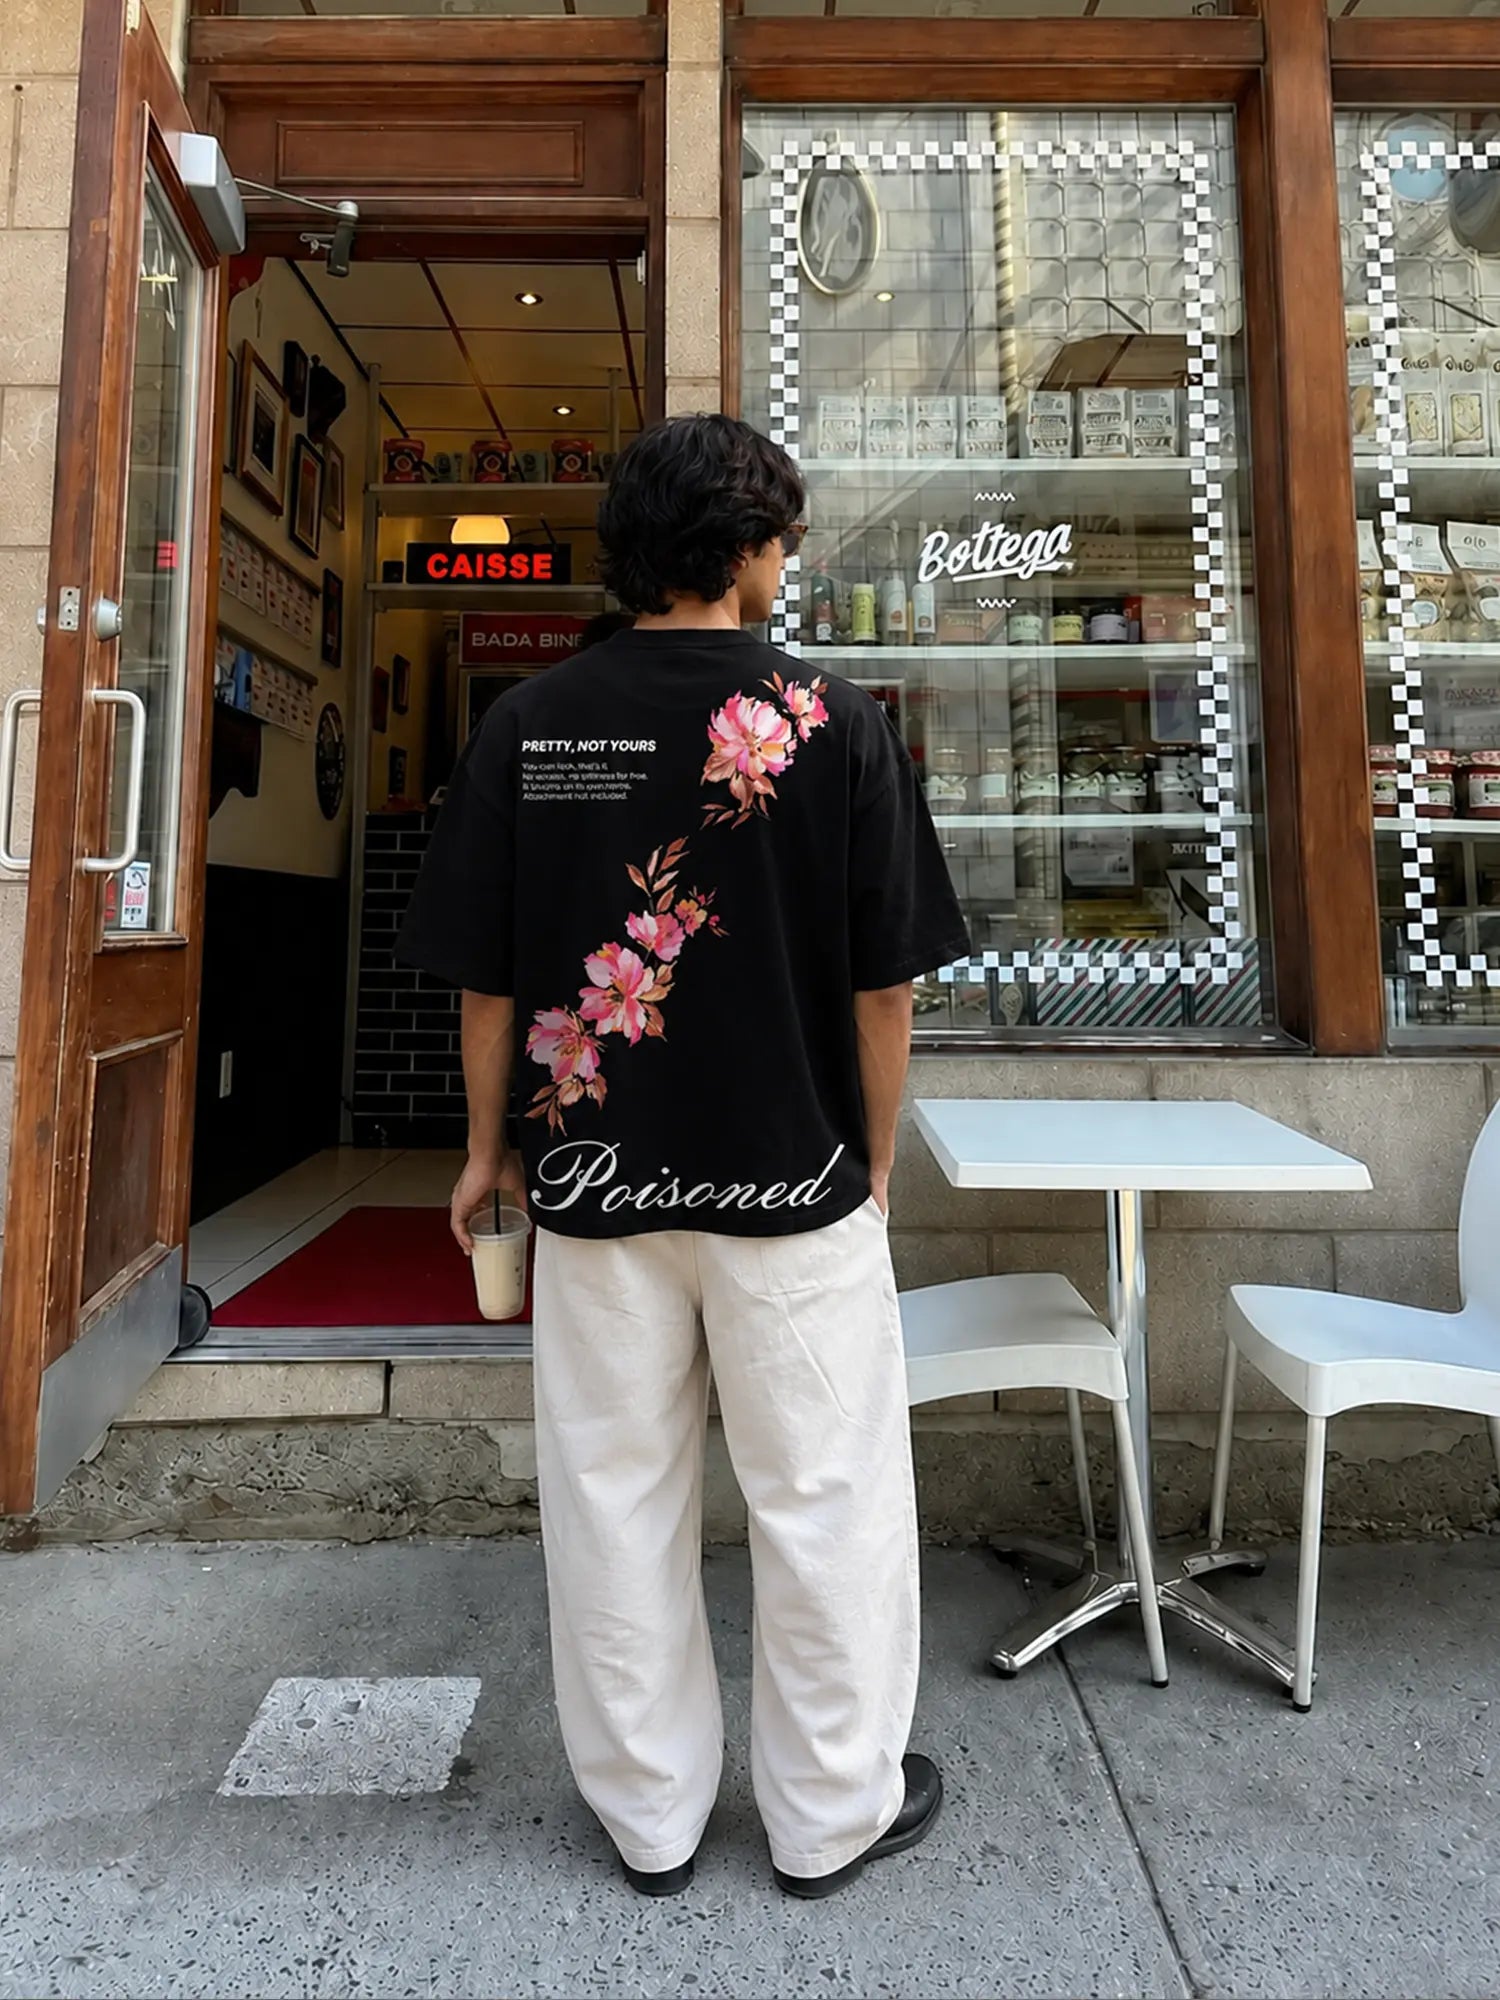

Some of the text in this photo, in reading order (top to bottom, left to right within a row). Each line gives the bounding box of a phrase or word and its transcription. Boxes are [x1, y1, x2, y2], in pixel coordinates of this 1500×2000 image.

[918, 521, 1073, 583] Bottega
[427, 553, 552, 579] CAISSE
[472, 632, 532, 647] BADA
[522, 740, 657, 753] PRETTY, NOT YOURS
[531, 1140, 845, 1212] Poisoned
